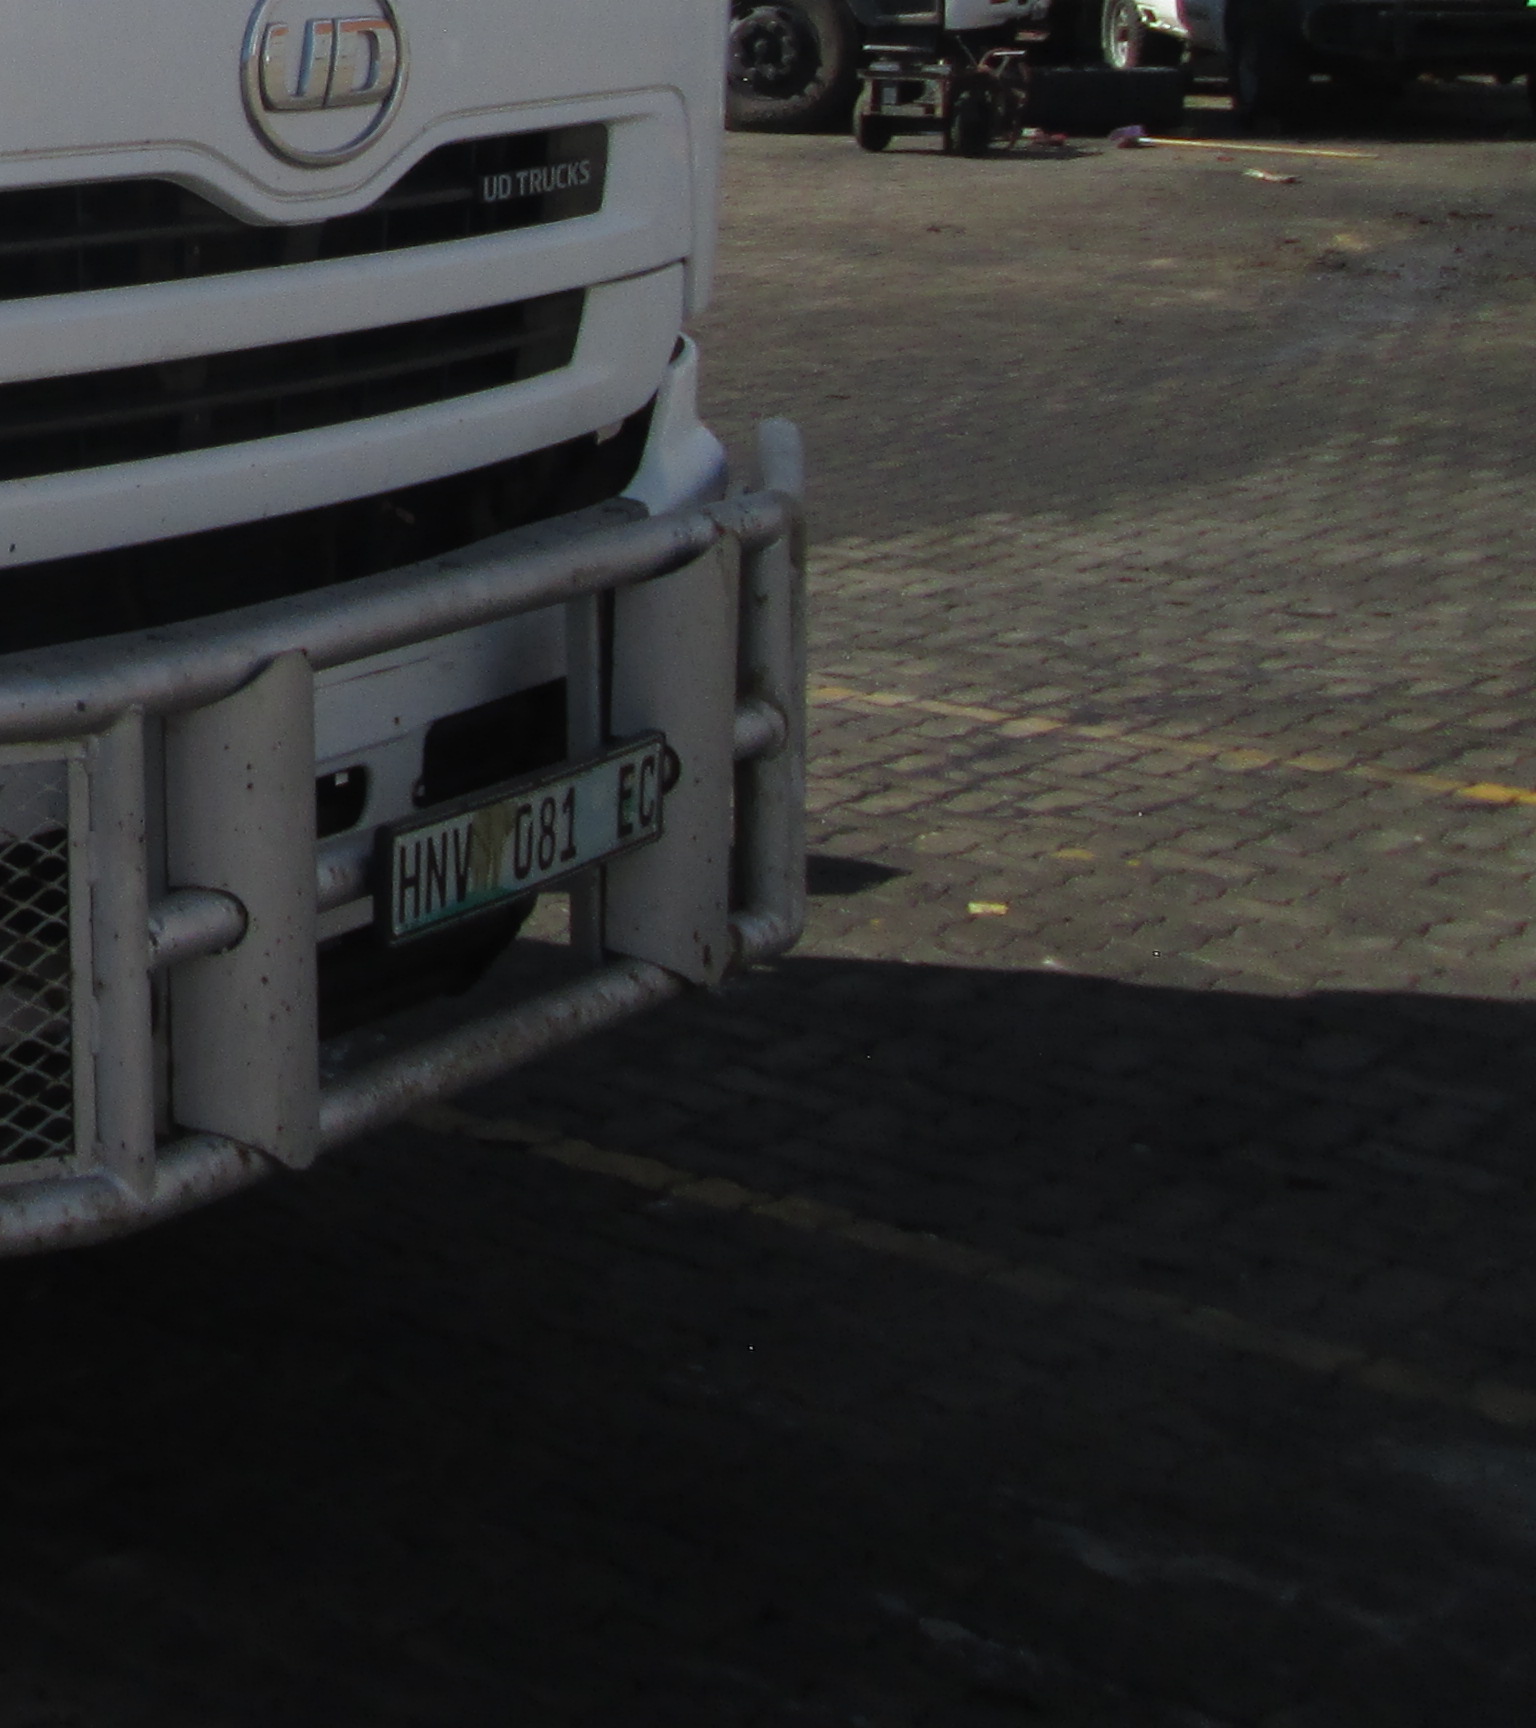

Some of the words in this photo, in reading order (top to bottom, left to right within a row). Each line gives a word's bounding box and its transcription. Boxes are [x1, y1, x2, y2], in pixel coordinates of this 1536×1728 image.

[483, 174, 512, 202] UD
[515, 160, 591, 196] TRUCKS
[398, 822, 474, 923] HNV
[513, 786, 577, 881] 081
[617, 755, 656, 839] EC
